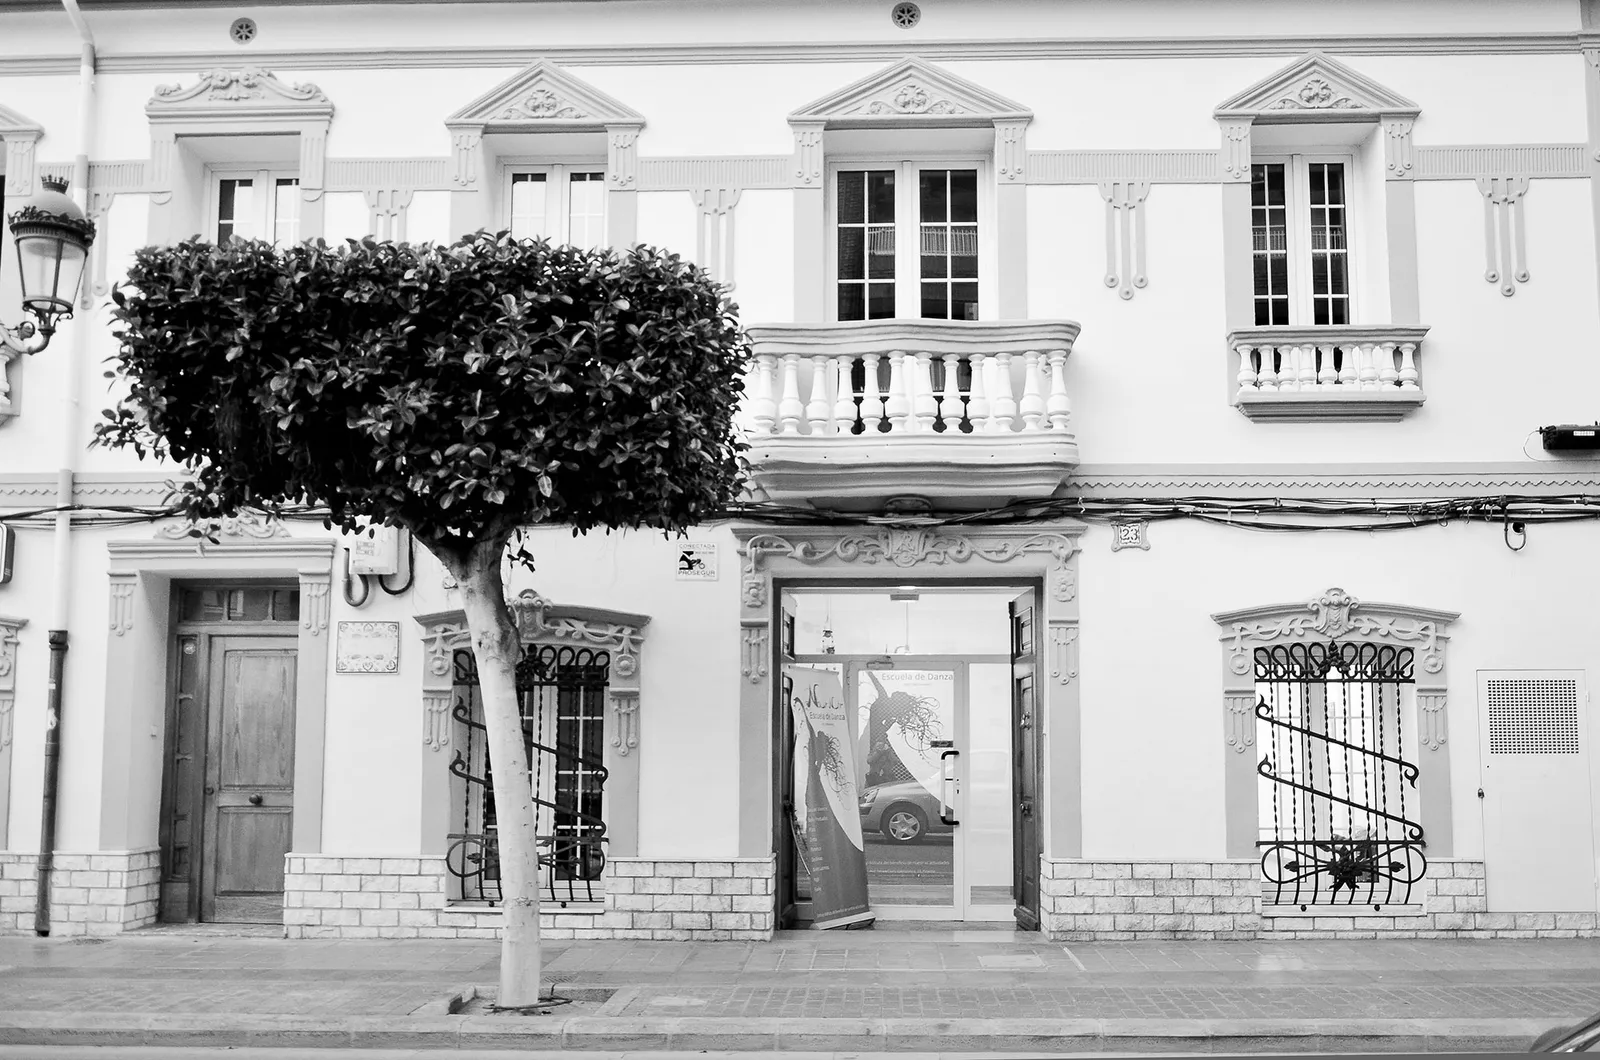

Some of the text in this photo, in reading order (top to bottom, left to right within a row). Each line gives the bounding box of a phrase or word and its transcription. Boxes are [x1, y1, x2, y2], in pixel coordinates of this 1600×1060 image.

[1122, 528, 1138, 541] 23
[882, 672, 954, 681] Escuela de Danza
